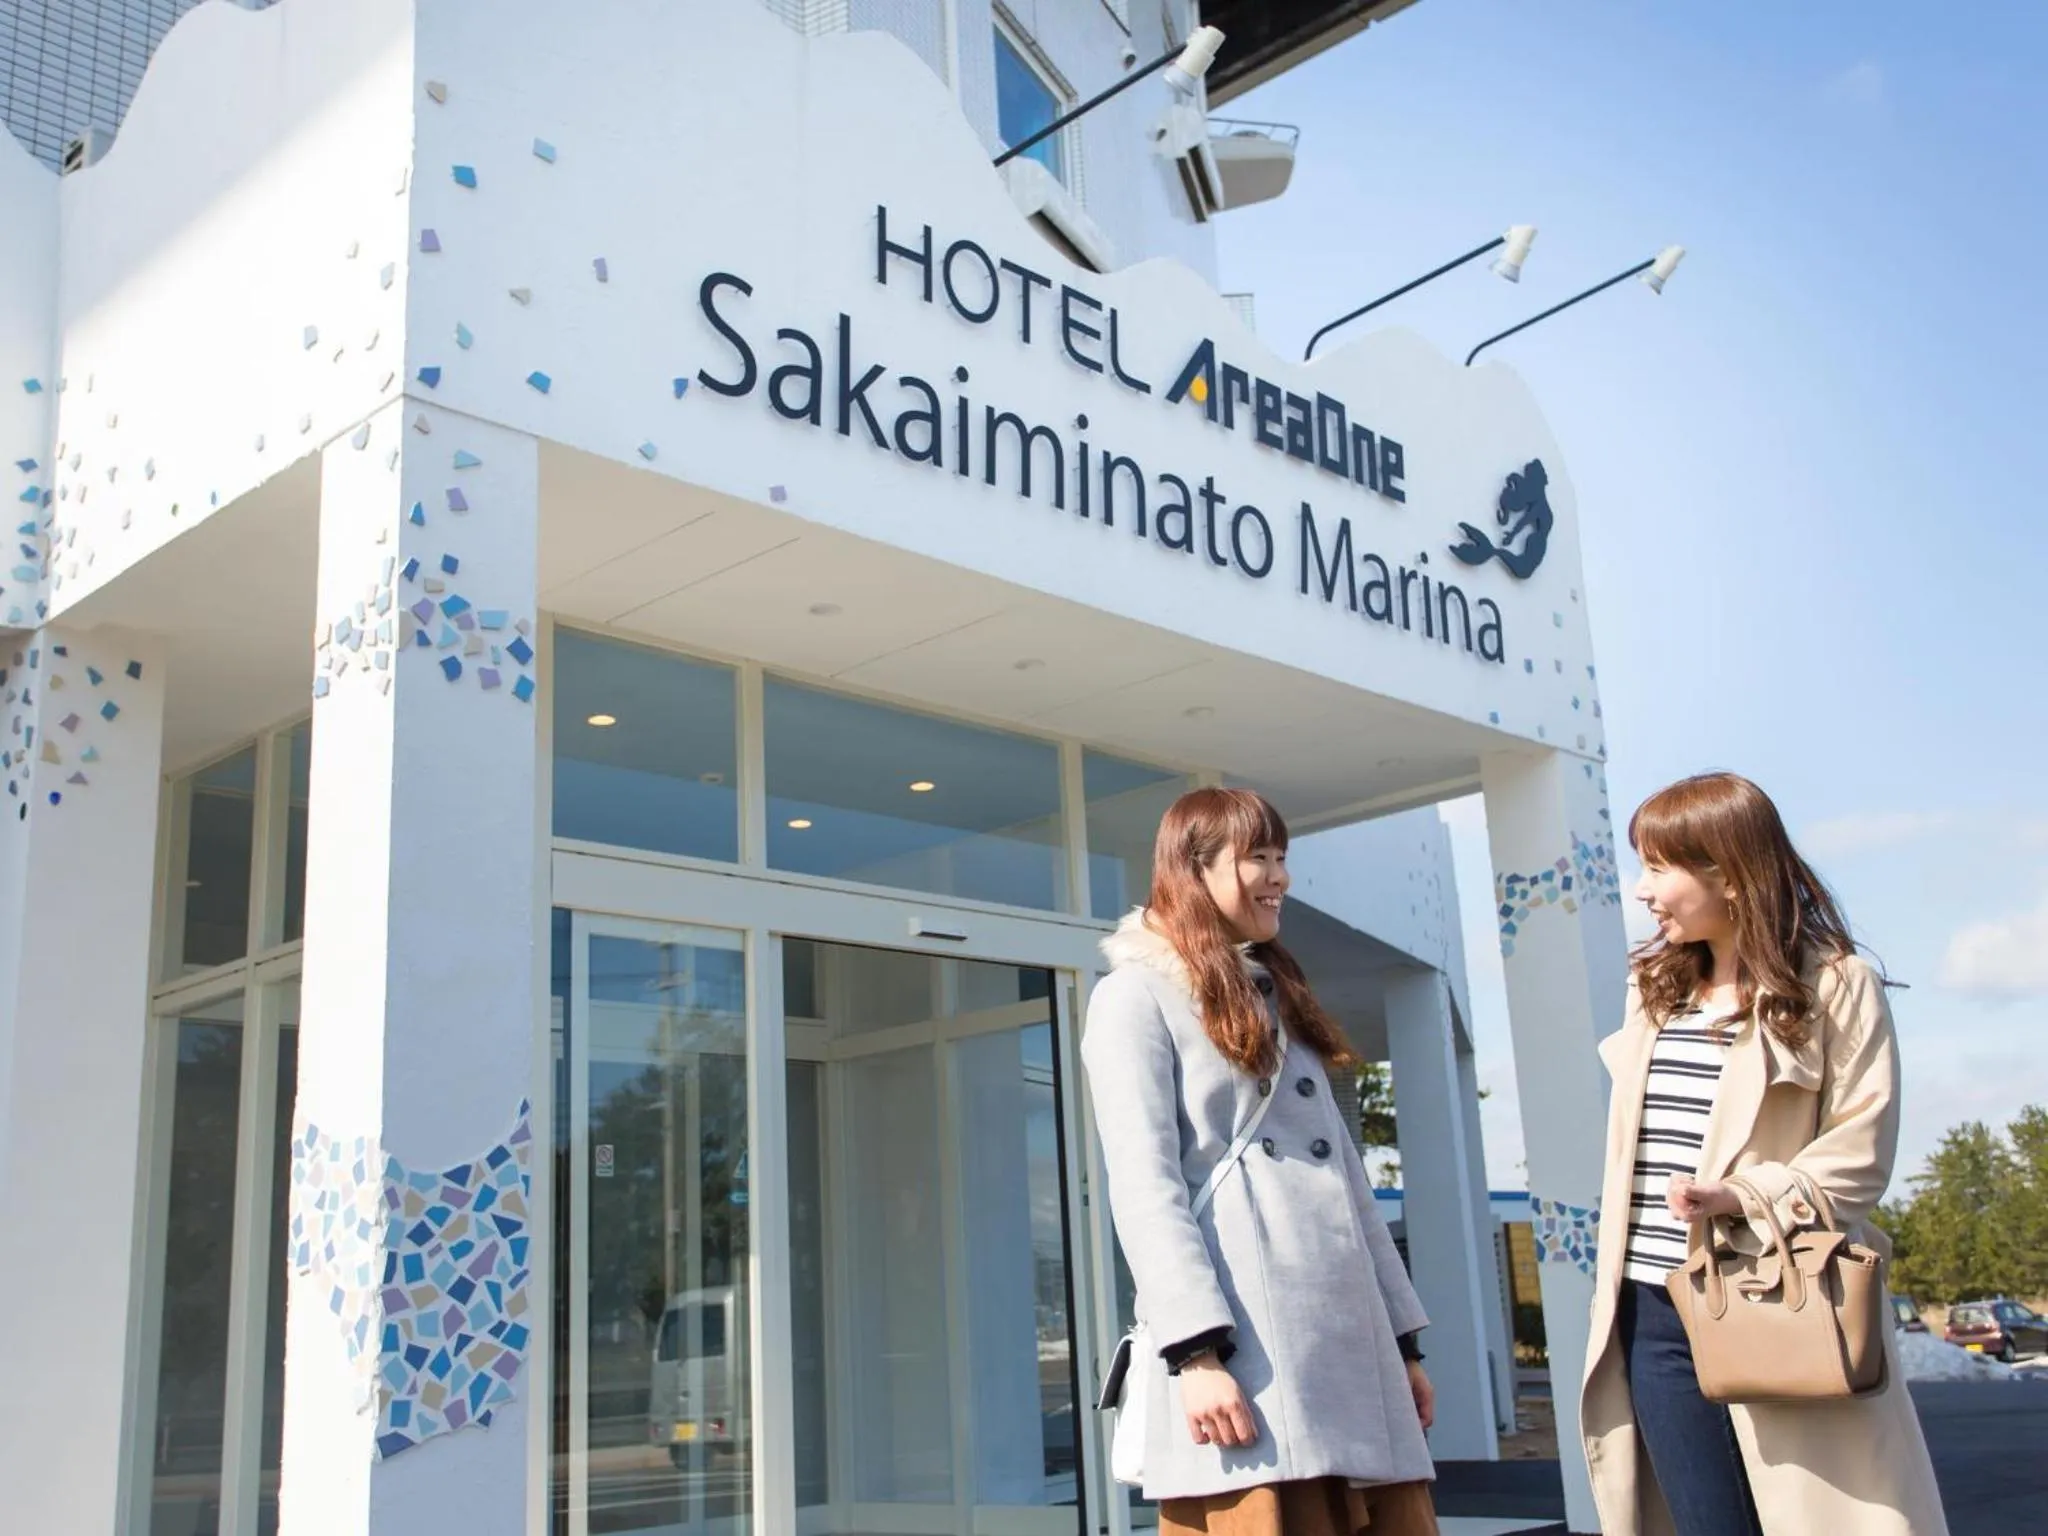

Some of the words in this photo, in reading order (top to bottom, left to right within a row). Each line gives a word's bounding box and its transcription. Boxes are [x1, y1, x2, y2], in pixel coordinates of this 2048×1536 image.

[697, 271, 1275, 580] Sakaiminato
[1300, 500, 1506, 665] Marina
[876, 204, 1151, 395] HOTEL
[1165, 337, 1407, 505] AreaOne
